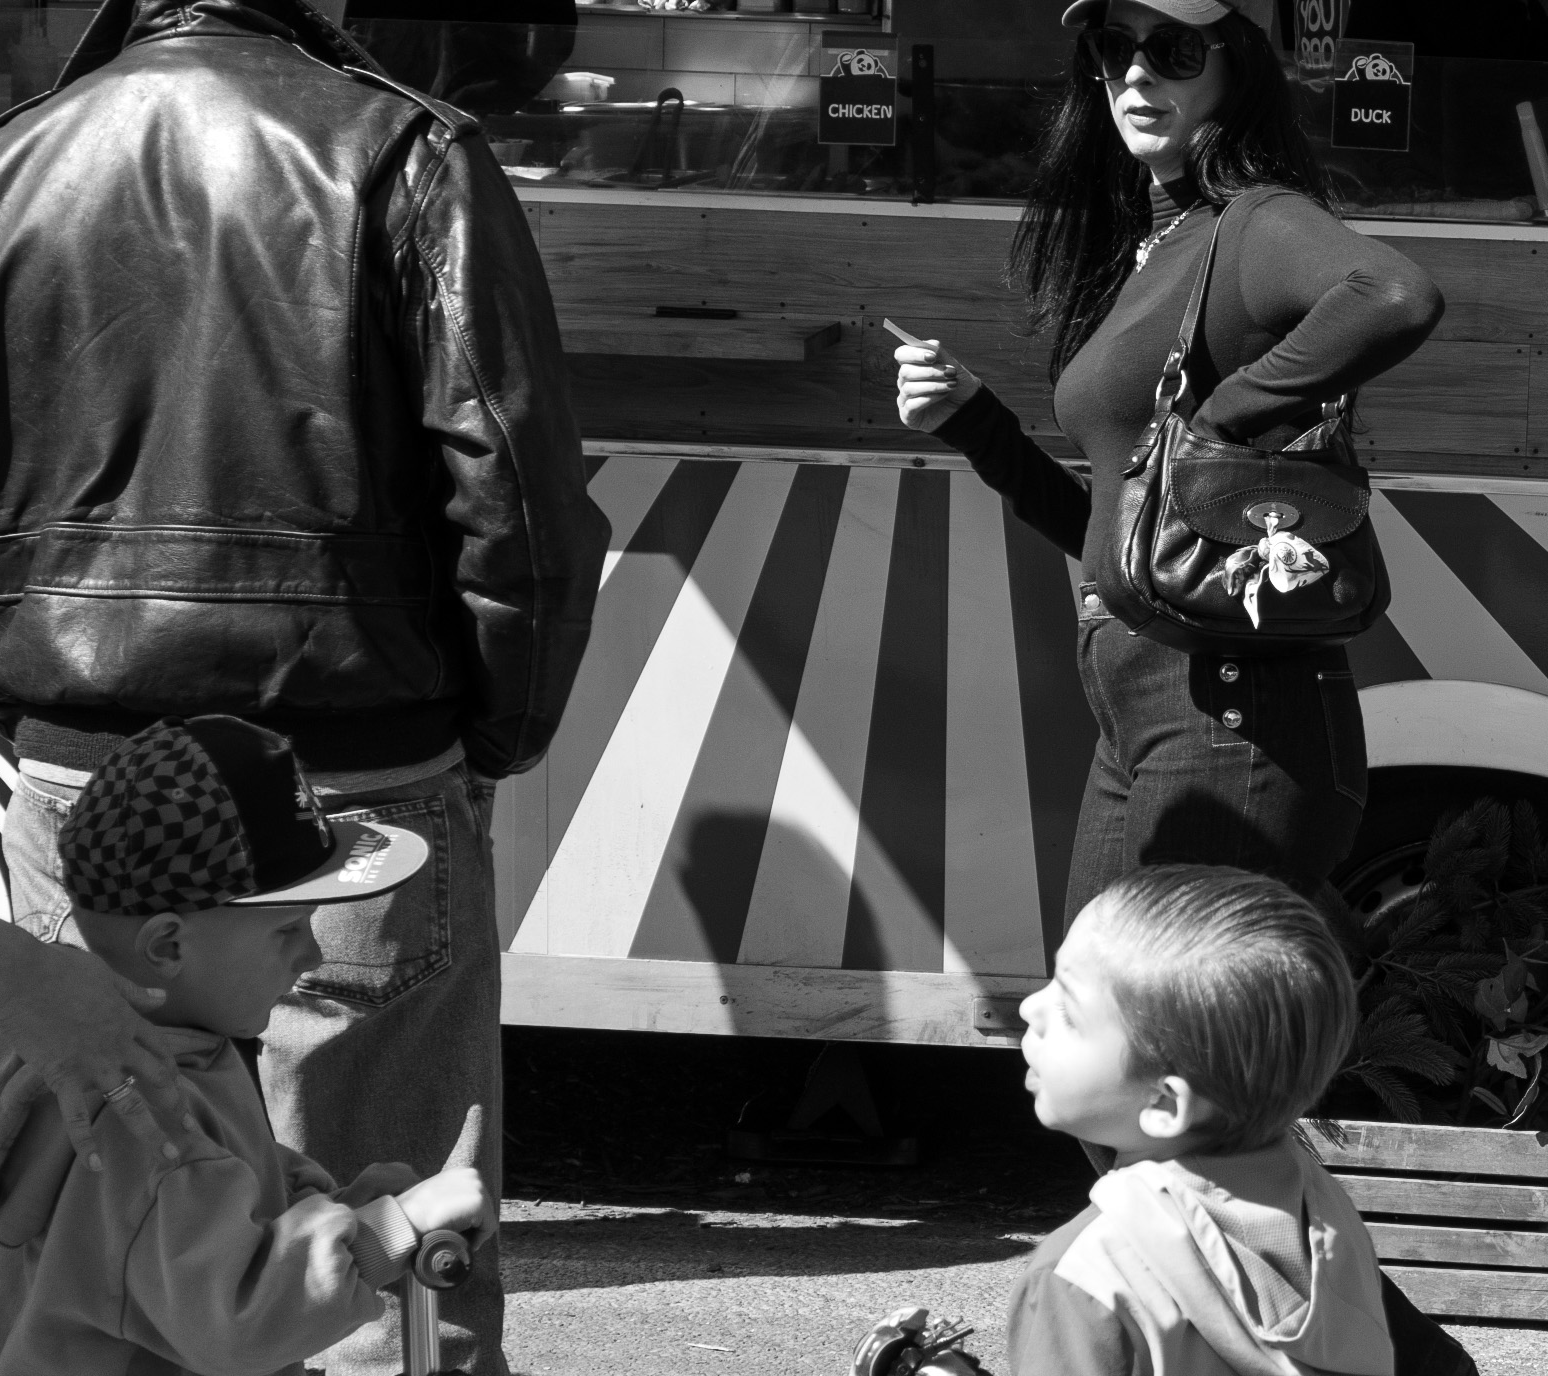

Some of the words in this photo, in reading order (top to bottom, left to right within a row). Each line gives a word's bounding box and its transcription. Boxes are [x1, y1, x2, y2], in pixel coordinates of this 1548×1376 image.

[827, 103, 894, 120] CHICKEN
[1350, 107, 1392, 124] DUCK
[338, 833, 383, 883] SONIC
